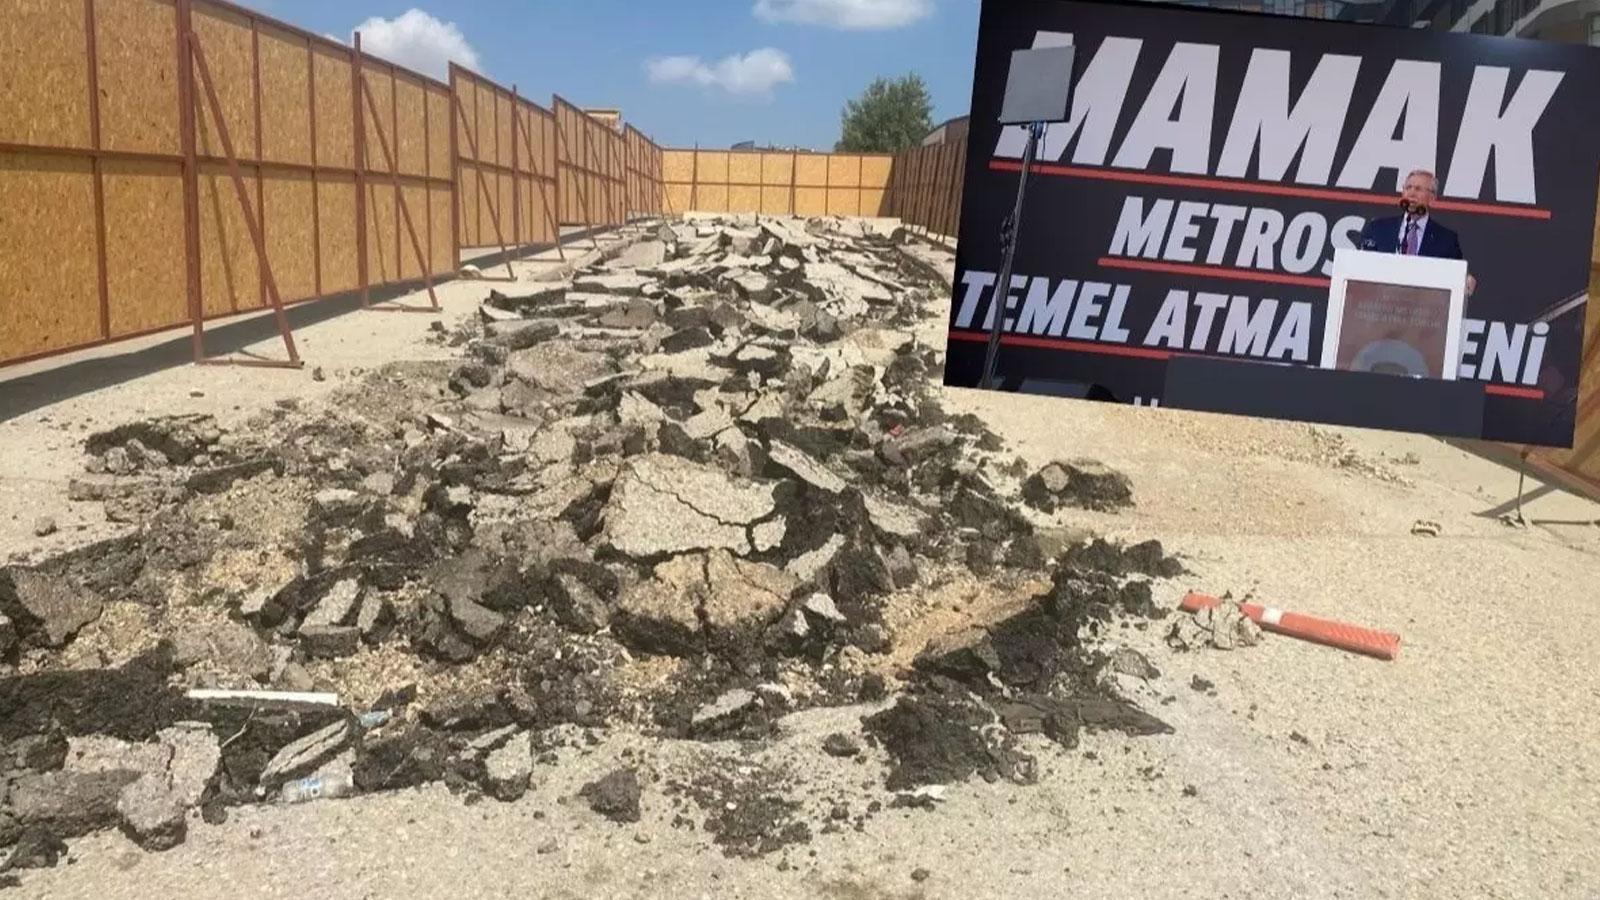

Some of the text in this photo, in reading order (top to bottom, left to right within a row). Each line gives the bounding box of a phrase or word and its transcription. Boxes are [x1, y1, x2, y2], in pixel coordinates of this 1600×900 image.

[993, 31, 1566, 205] MAMAK
[1109, 196, 1365, 277] METROS
[954, 270, 1131, 343] TEMEL
[1142, 289, 1312, 362] ATMA
